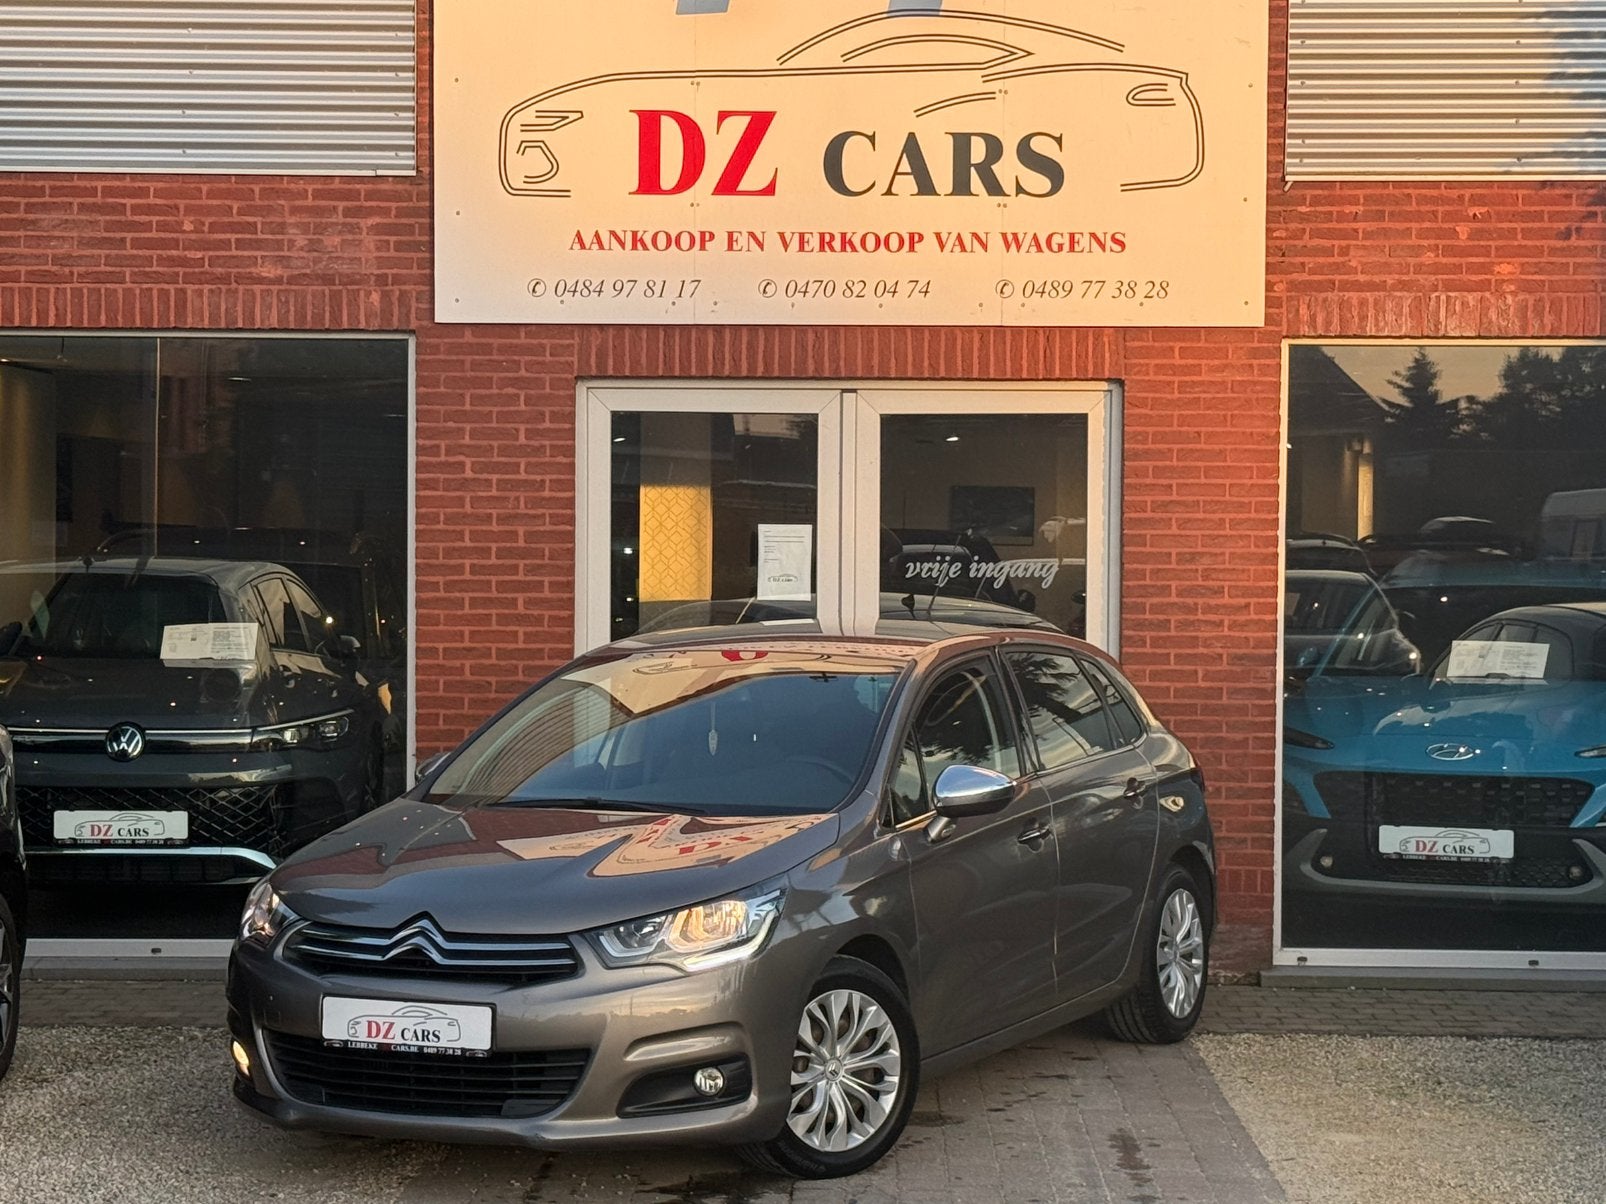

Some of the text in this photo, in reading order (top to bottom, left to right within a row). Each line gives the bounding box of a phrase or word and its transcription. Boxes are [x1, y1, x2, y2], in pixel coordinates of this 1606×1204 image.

[628, 109, 1065, 198] DZ CARS
[569, 229, 1127, 254] AANKOOP EN VERKOOP VAN WAGENS
[554, 278, 701, 299] 0484 97 81 17
[785, 279, 931, 299] 0470 82 04 74
[1022, 279, 1169, 299] 0489 77 38 28
[905, 555, 1060, 588] vrije ingang
[90, 824, 149, 837] DZ CARS
[1415, 840, 1475, 854] DZ CARS
[366, 1020, 441, 1043] DZ CARS
